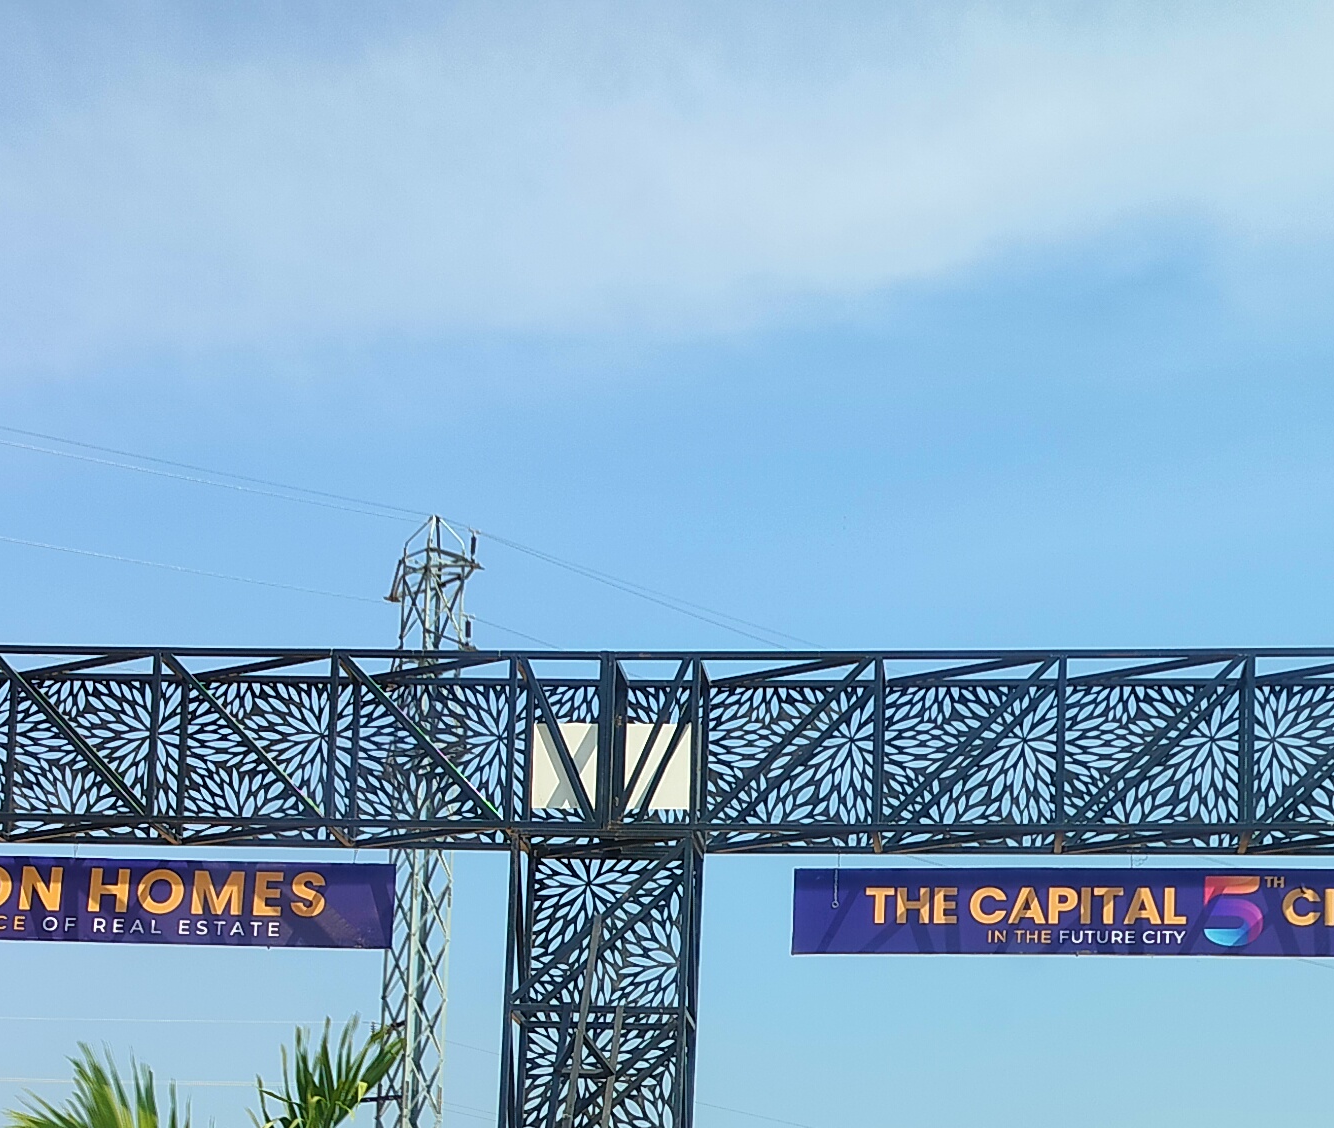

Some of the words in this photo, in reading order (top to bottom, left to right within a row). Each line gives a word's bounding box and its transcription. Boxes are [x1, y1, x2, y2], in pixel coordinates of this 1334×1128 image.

[87, 867, 327, 918] HOMES
[865, 886, 958, 925] THE
[969, 886, 1187, 926] CAPITAL
[42, 916, 77, 933] OF
[92, 917, 162, 935] REAL
[178, 919, 281, 938] ESTATE
[987, 929, 1007, 944] IN
[1014, 929, 1052, 944] THE
[1059, 929, 1136, 945] FUTURE
[1142, 930, 1186, 945] CITY
